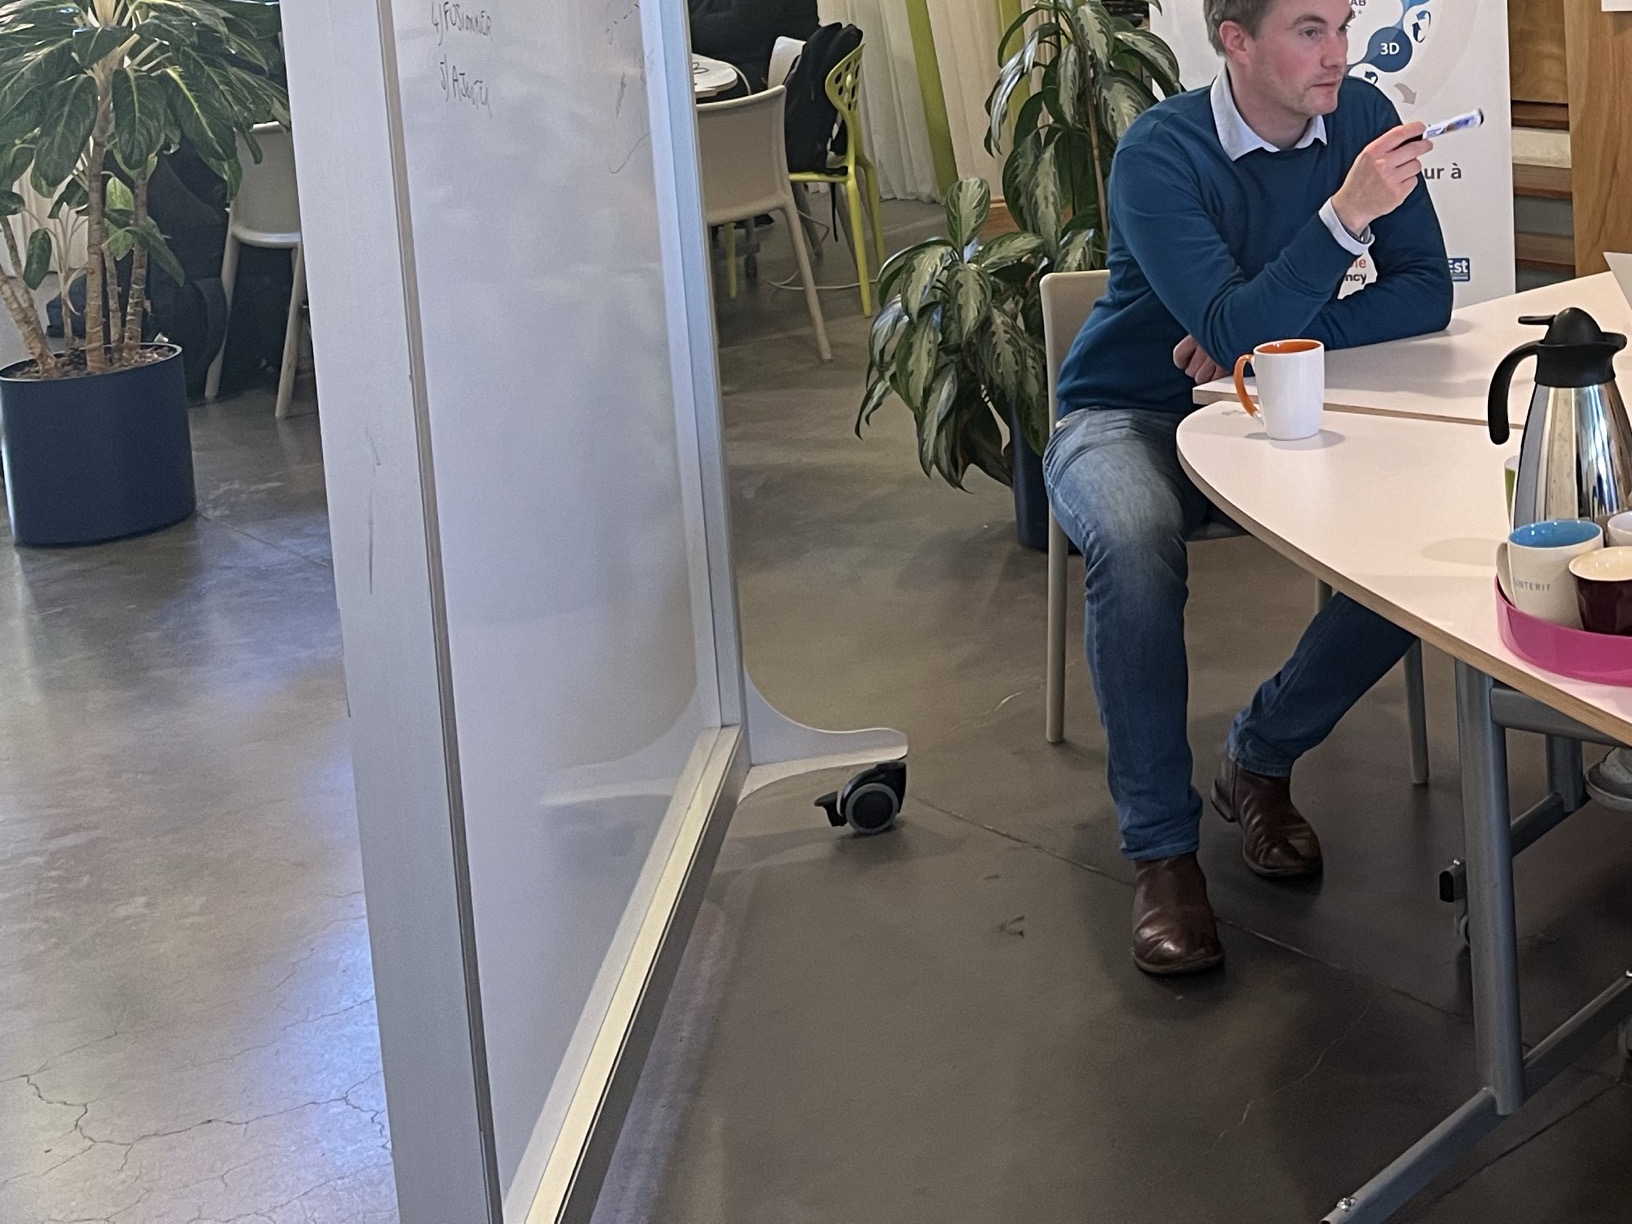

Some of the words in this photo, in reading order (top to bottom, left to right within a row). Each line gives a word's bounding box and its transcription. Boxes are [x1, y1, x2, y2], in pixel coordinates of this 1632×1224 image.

[1380, 42, 1400, 56] 3D
[1424, 167, 1444, 180] ur
[1450, 162, 1462, 180] à
[1344, 273, 1367, 284] ncy
